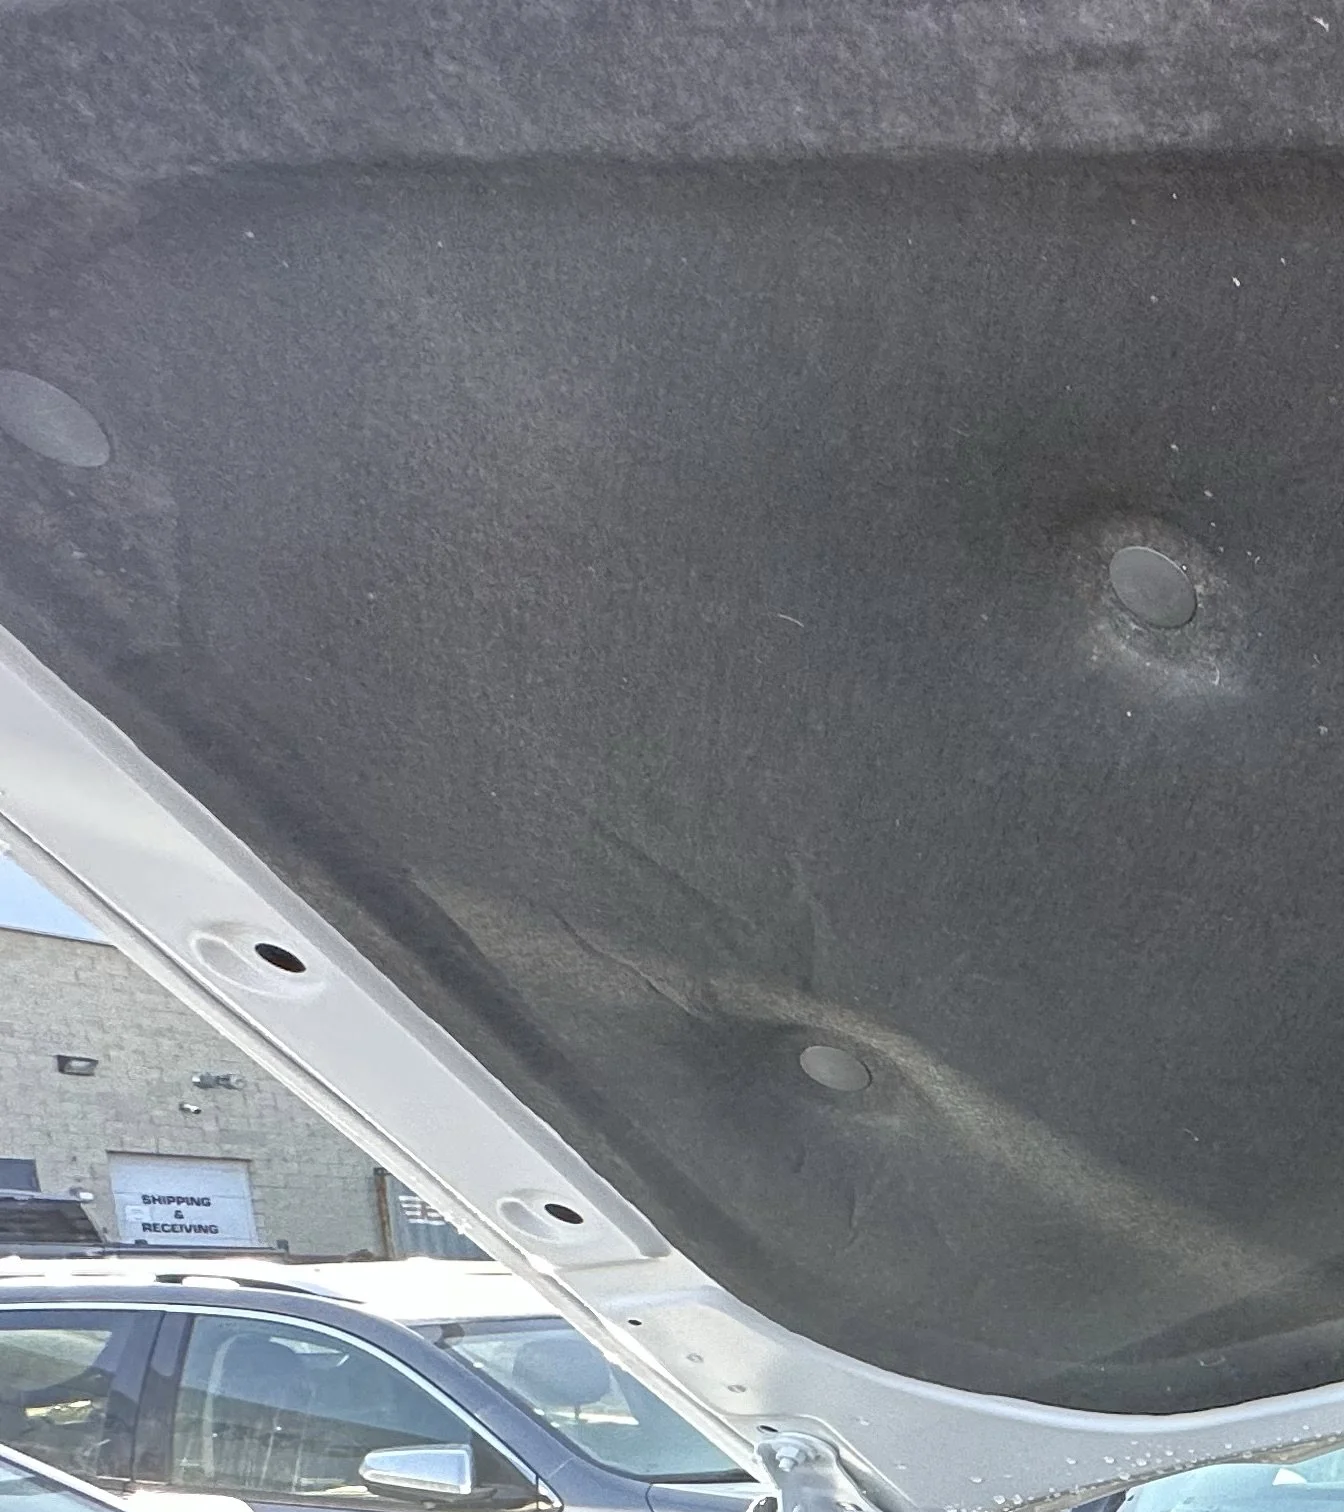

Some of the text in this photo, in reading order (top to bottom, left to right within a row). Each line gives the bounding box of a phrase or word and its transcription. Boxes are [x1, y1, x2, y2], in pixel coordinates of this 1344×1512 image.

[141, 1194, 211, 1207] SHIPPING
[174, 1210, 184, 1219] &
[141, 1223, 219, 1234] RECEIVING
